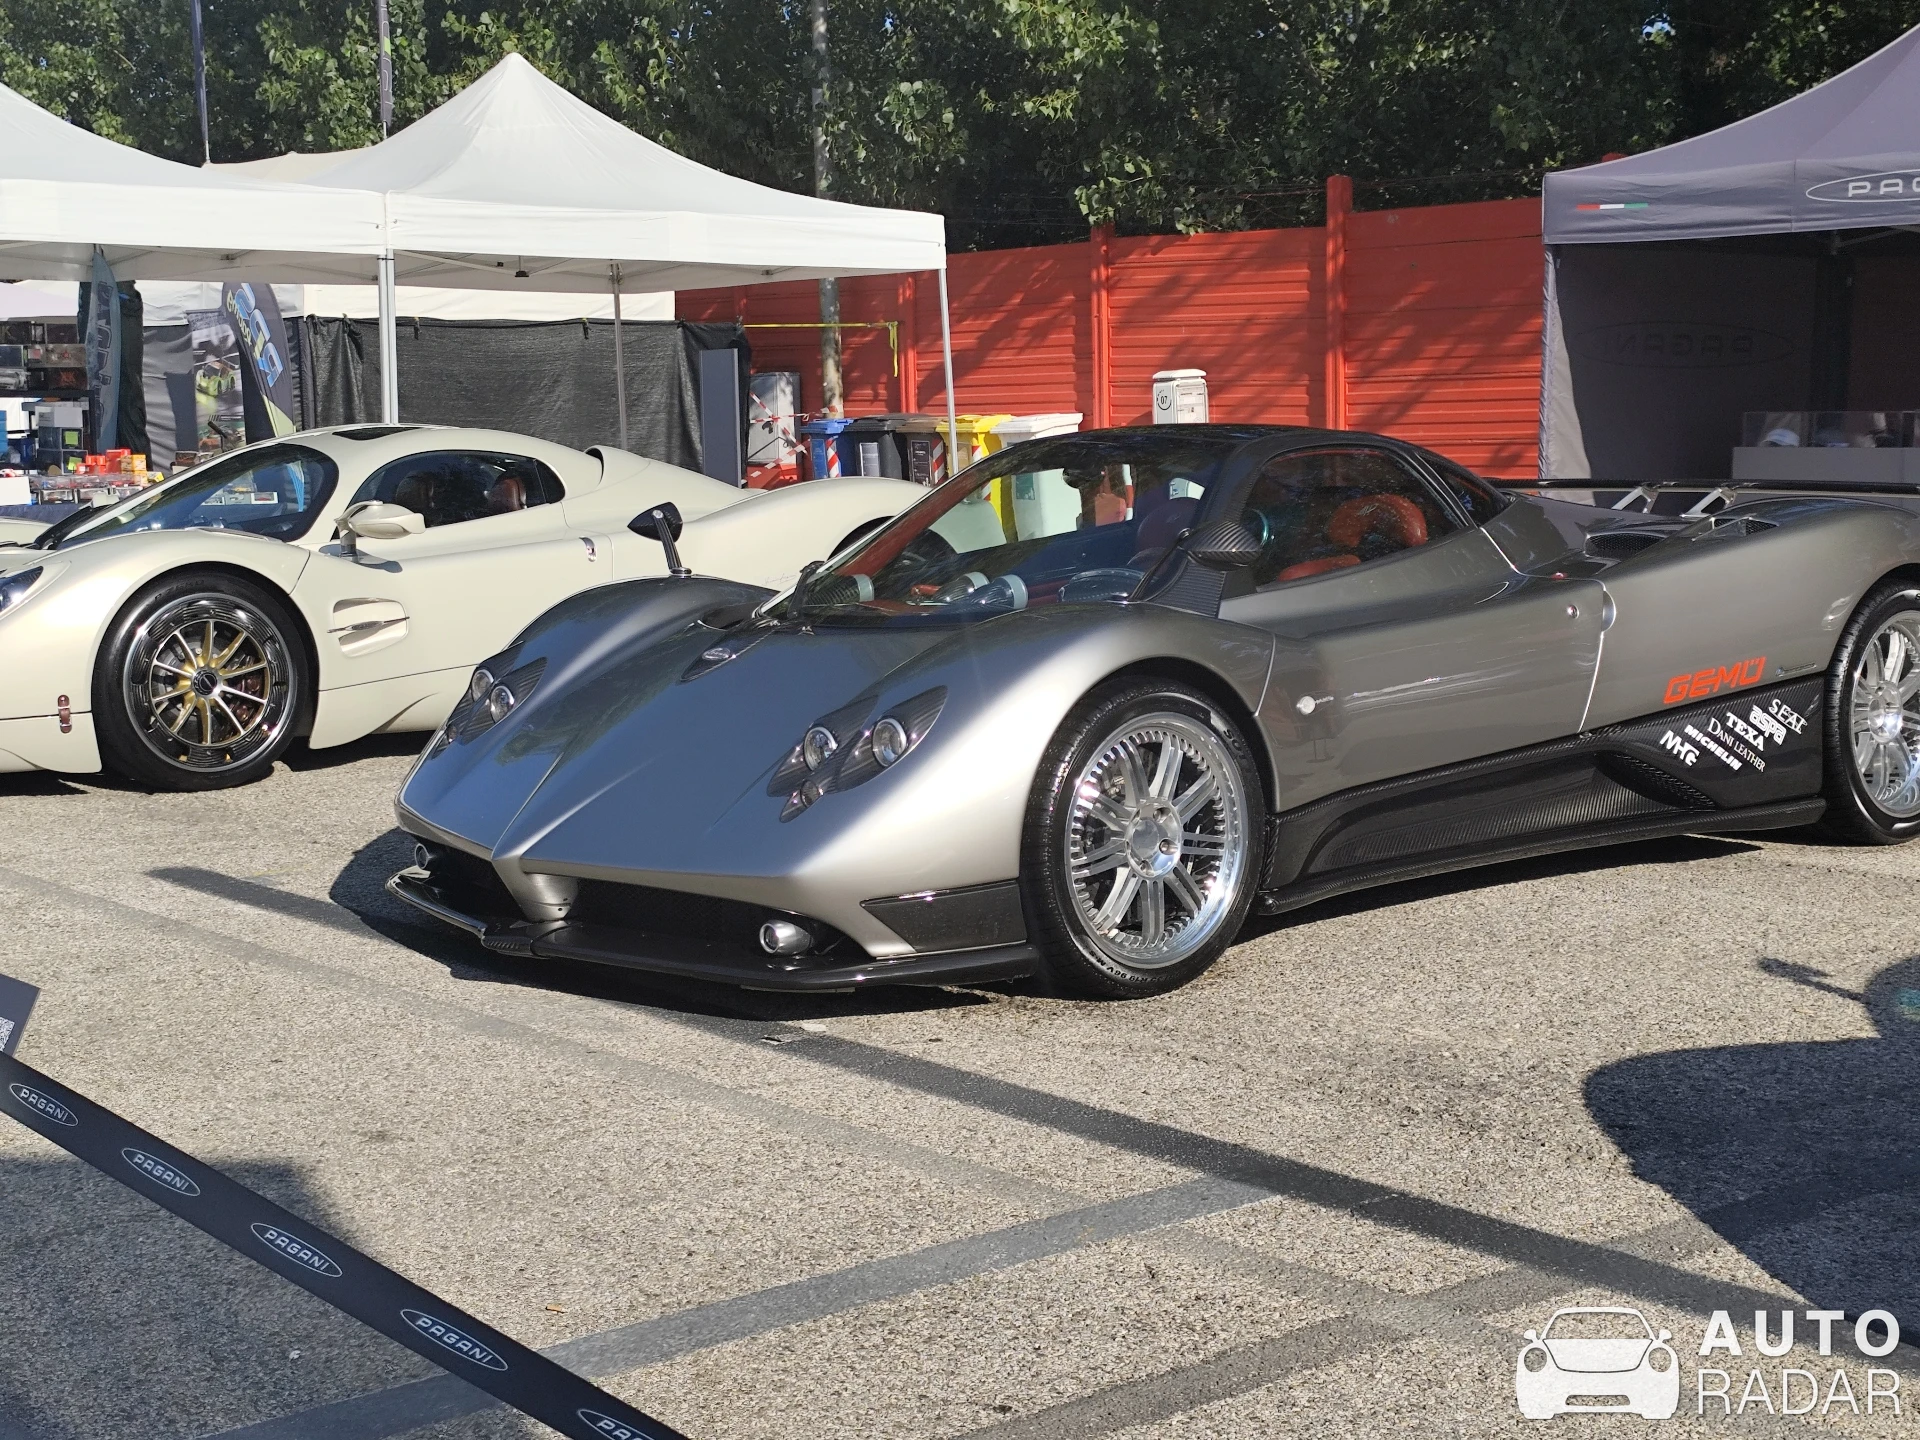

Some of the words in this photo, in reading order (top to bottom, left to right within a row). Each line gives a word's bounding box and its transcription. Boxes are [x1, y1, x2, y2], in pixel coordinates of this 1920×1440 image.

[1684, 724, 1742, 771] MICHELIN
[1725, 711, 1764, 752] TEXA
[1733, 740, 1766, 773] LEATHER
[19, 1088, 69, 1122] PAGANI
[132, 1154, 189, 1191] PAGANI
[264, 1229, 330, 1272] PAGANI
[415, 1317, 494, 1364] PAGANI
